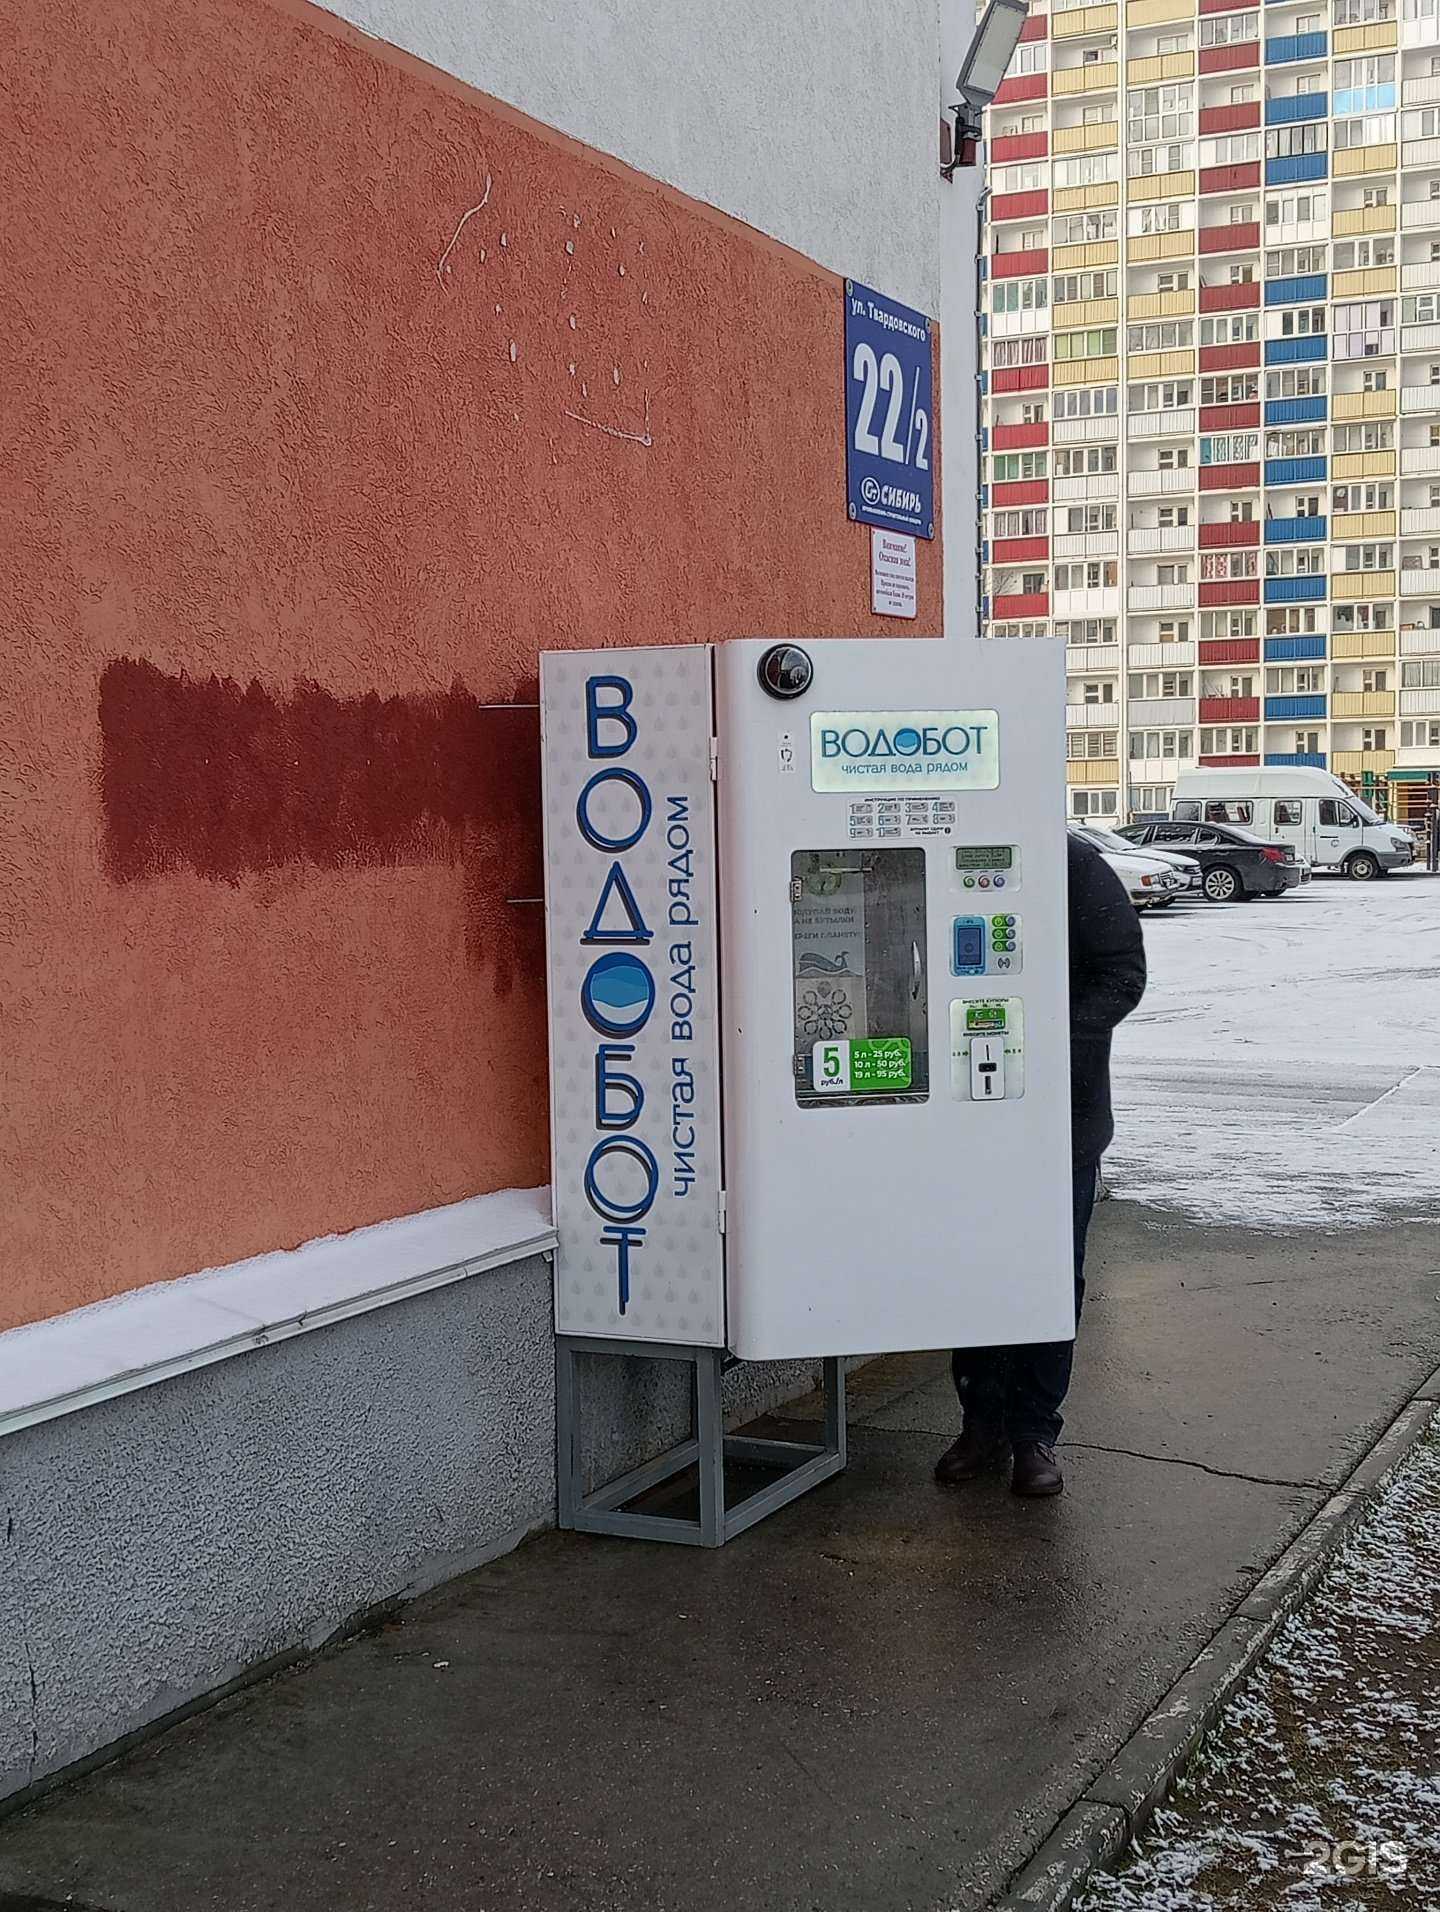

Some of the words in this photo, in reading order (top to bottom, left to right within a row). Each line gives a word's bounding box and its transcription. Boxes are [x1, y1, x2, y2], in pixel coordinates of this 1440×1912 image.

[851, 298, 866, 316] ул.
[867, 301, 926, 341] Твардовского
[881, 484, 922, 513] СИБИРЬ
[820, 726, 988, 758] ВОДОБОТ
[841, 763, 887, 775] чистая
[890, 762, 923, 775] вода
[926, 761, 968, 775] рядом
[666, 796, 699, 926] рядом
[576, 675, 659, 1316] ВОДОБОТ
[669, 941, 696, 1041] вода
[823, 1047, 840, 1077] 5
[854, 1051, 860, 1059] 5
[873, 1050, 883, 1058] 25
[854, 1061, 863, 1069] 10
[877, 1060, 888, 1068] 50
[854, 1071, 863, 1079] 19
[877, 1070, 887, 1078] 95
[672, 1057, 696, 1197] чистая
